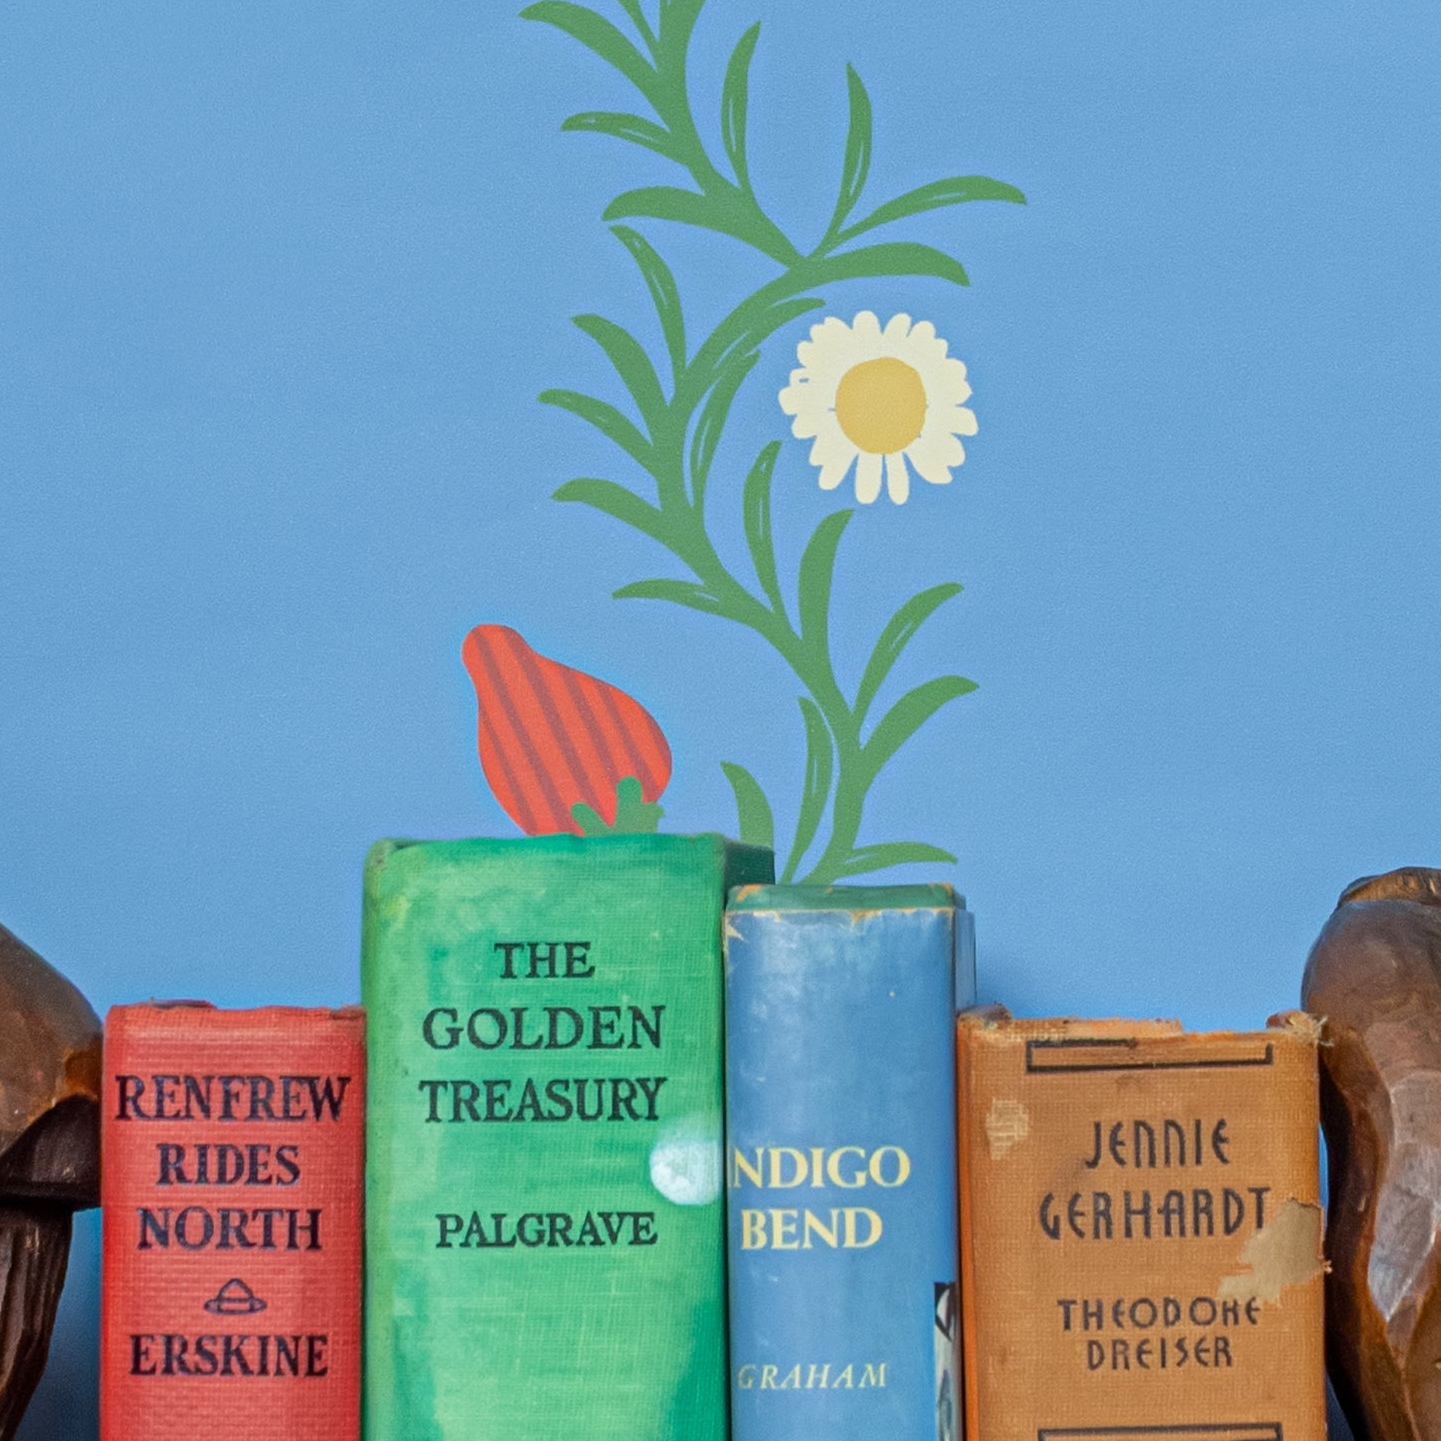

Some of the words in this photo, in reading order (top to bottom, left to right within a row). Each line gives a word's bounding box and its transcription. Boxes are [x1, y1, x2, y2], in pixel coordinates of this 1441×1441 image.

[493, 940, 596, 980] THE
[421, 1004, 666, 1051] GOLDEN
[114, 1074, 352, 1123] RENFREW
[418, 1076, 668, 1124] TREASURY
[155, 1143, 301, 1187] RIDES
[1084, 1118, 1231, 1169] JENNIE
[136, 1206, 324, 1252] NORTH
[434, 1210, 659, 1249] PALGRAVE
[740, 1206, 884, 1251] BEND
[1039, 1186, 1272, 1241] GERHARDT
[129, 1333, 330, 1378] ERSKINE
[736, 1361, 889, 1391] GRAHAM
[1086, 1336, 1234, 1372] DREISER
